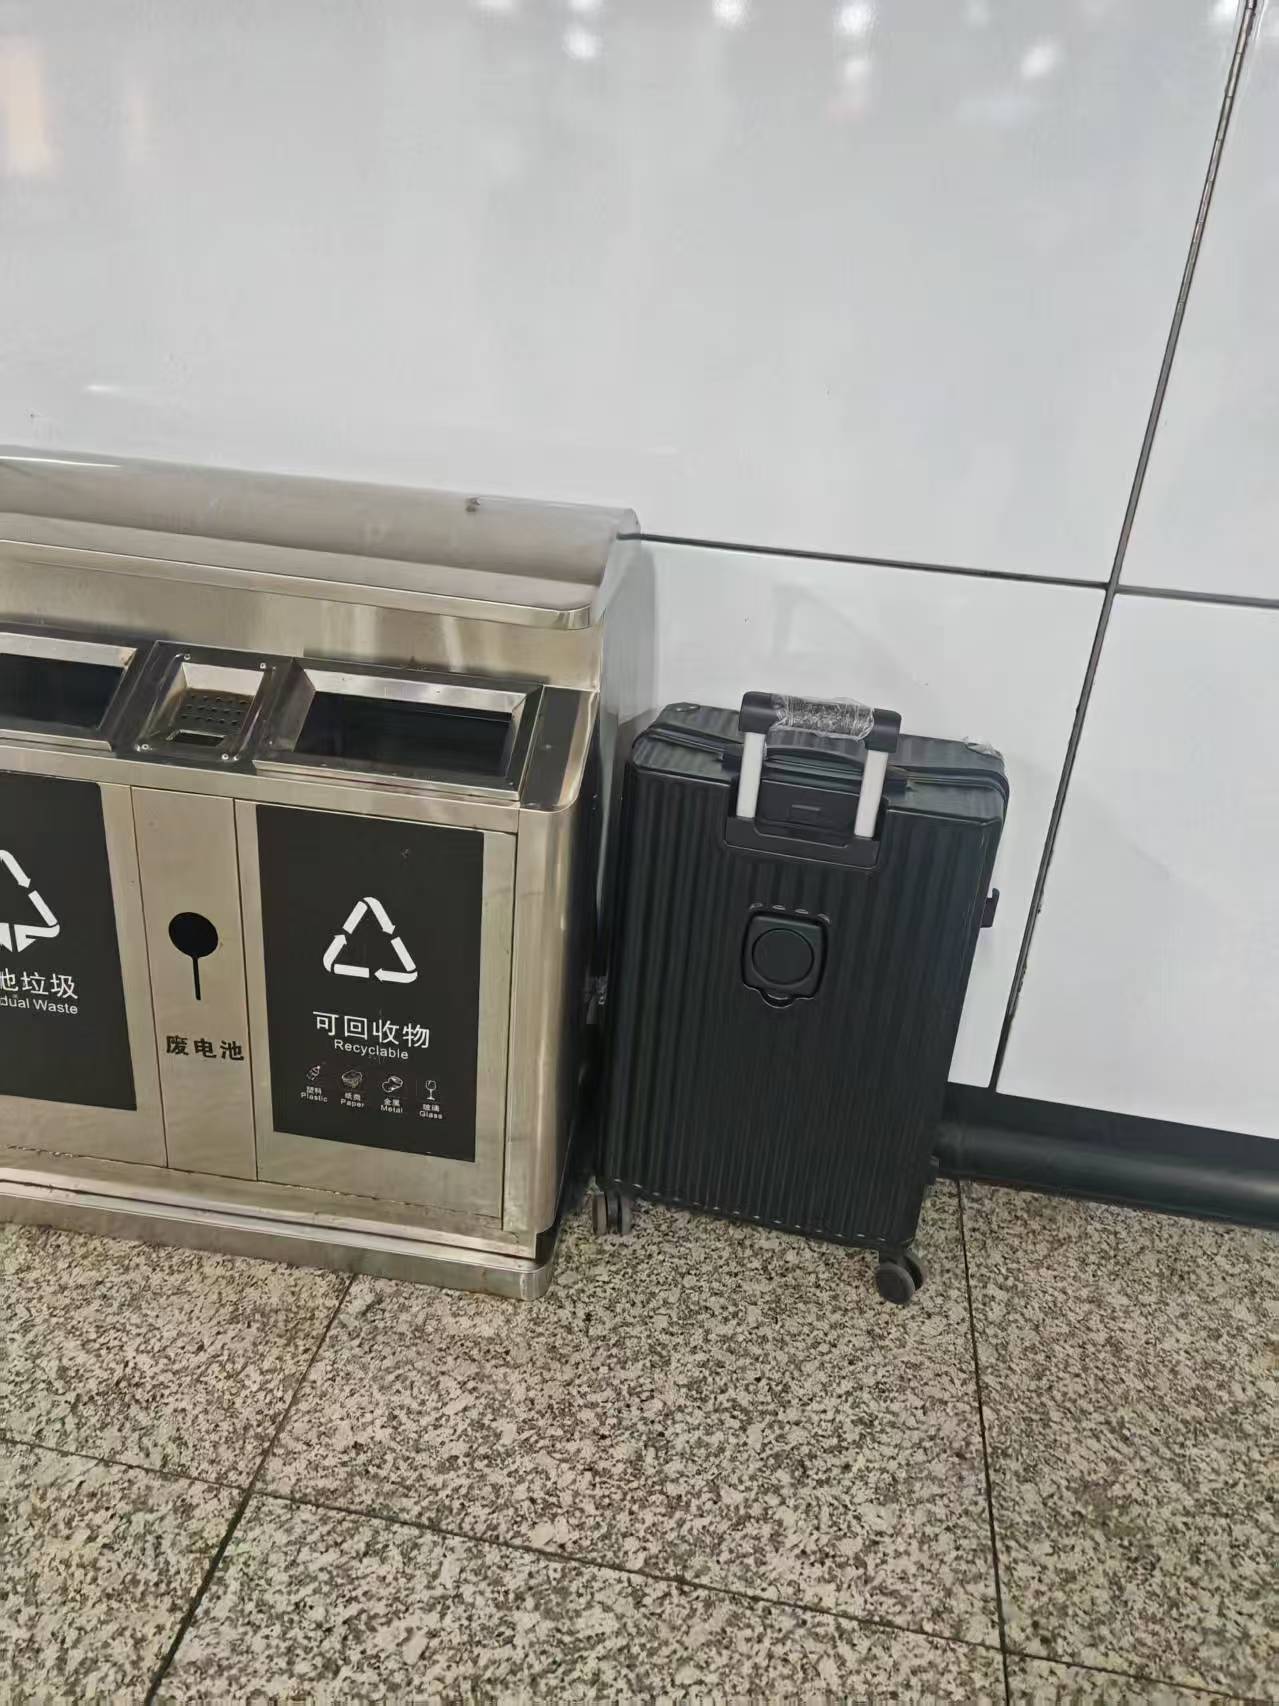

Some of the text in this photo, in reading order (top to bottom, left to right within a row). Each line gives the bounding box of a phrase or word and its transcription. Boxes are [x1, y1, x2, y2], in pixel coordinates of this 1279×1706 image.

[33, 999, 78, 1015] Waste
[313, 1011, 430, 1049] 可回收物
[166, 1034, 244, 1061] 废电池
[334, 1039, 409, 1060] Recyclable
[300, 1091, 328, 1103] Plastic
[340, 1098, 365, 1108] Paper
[380, 1105, 403, 1114] Metal
[419, 1110, 443, 1120] Glass
